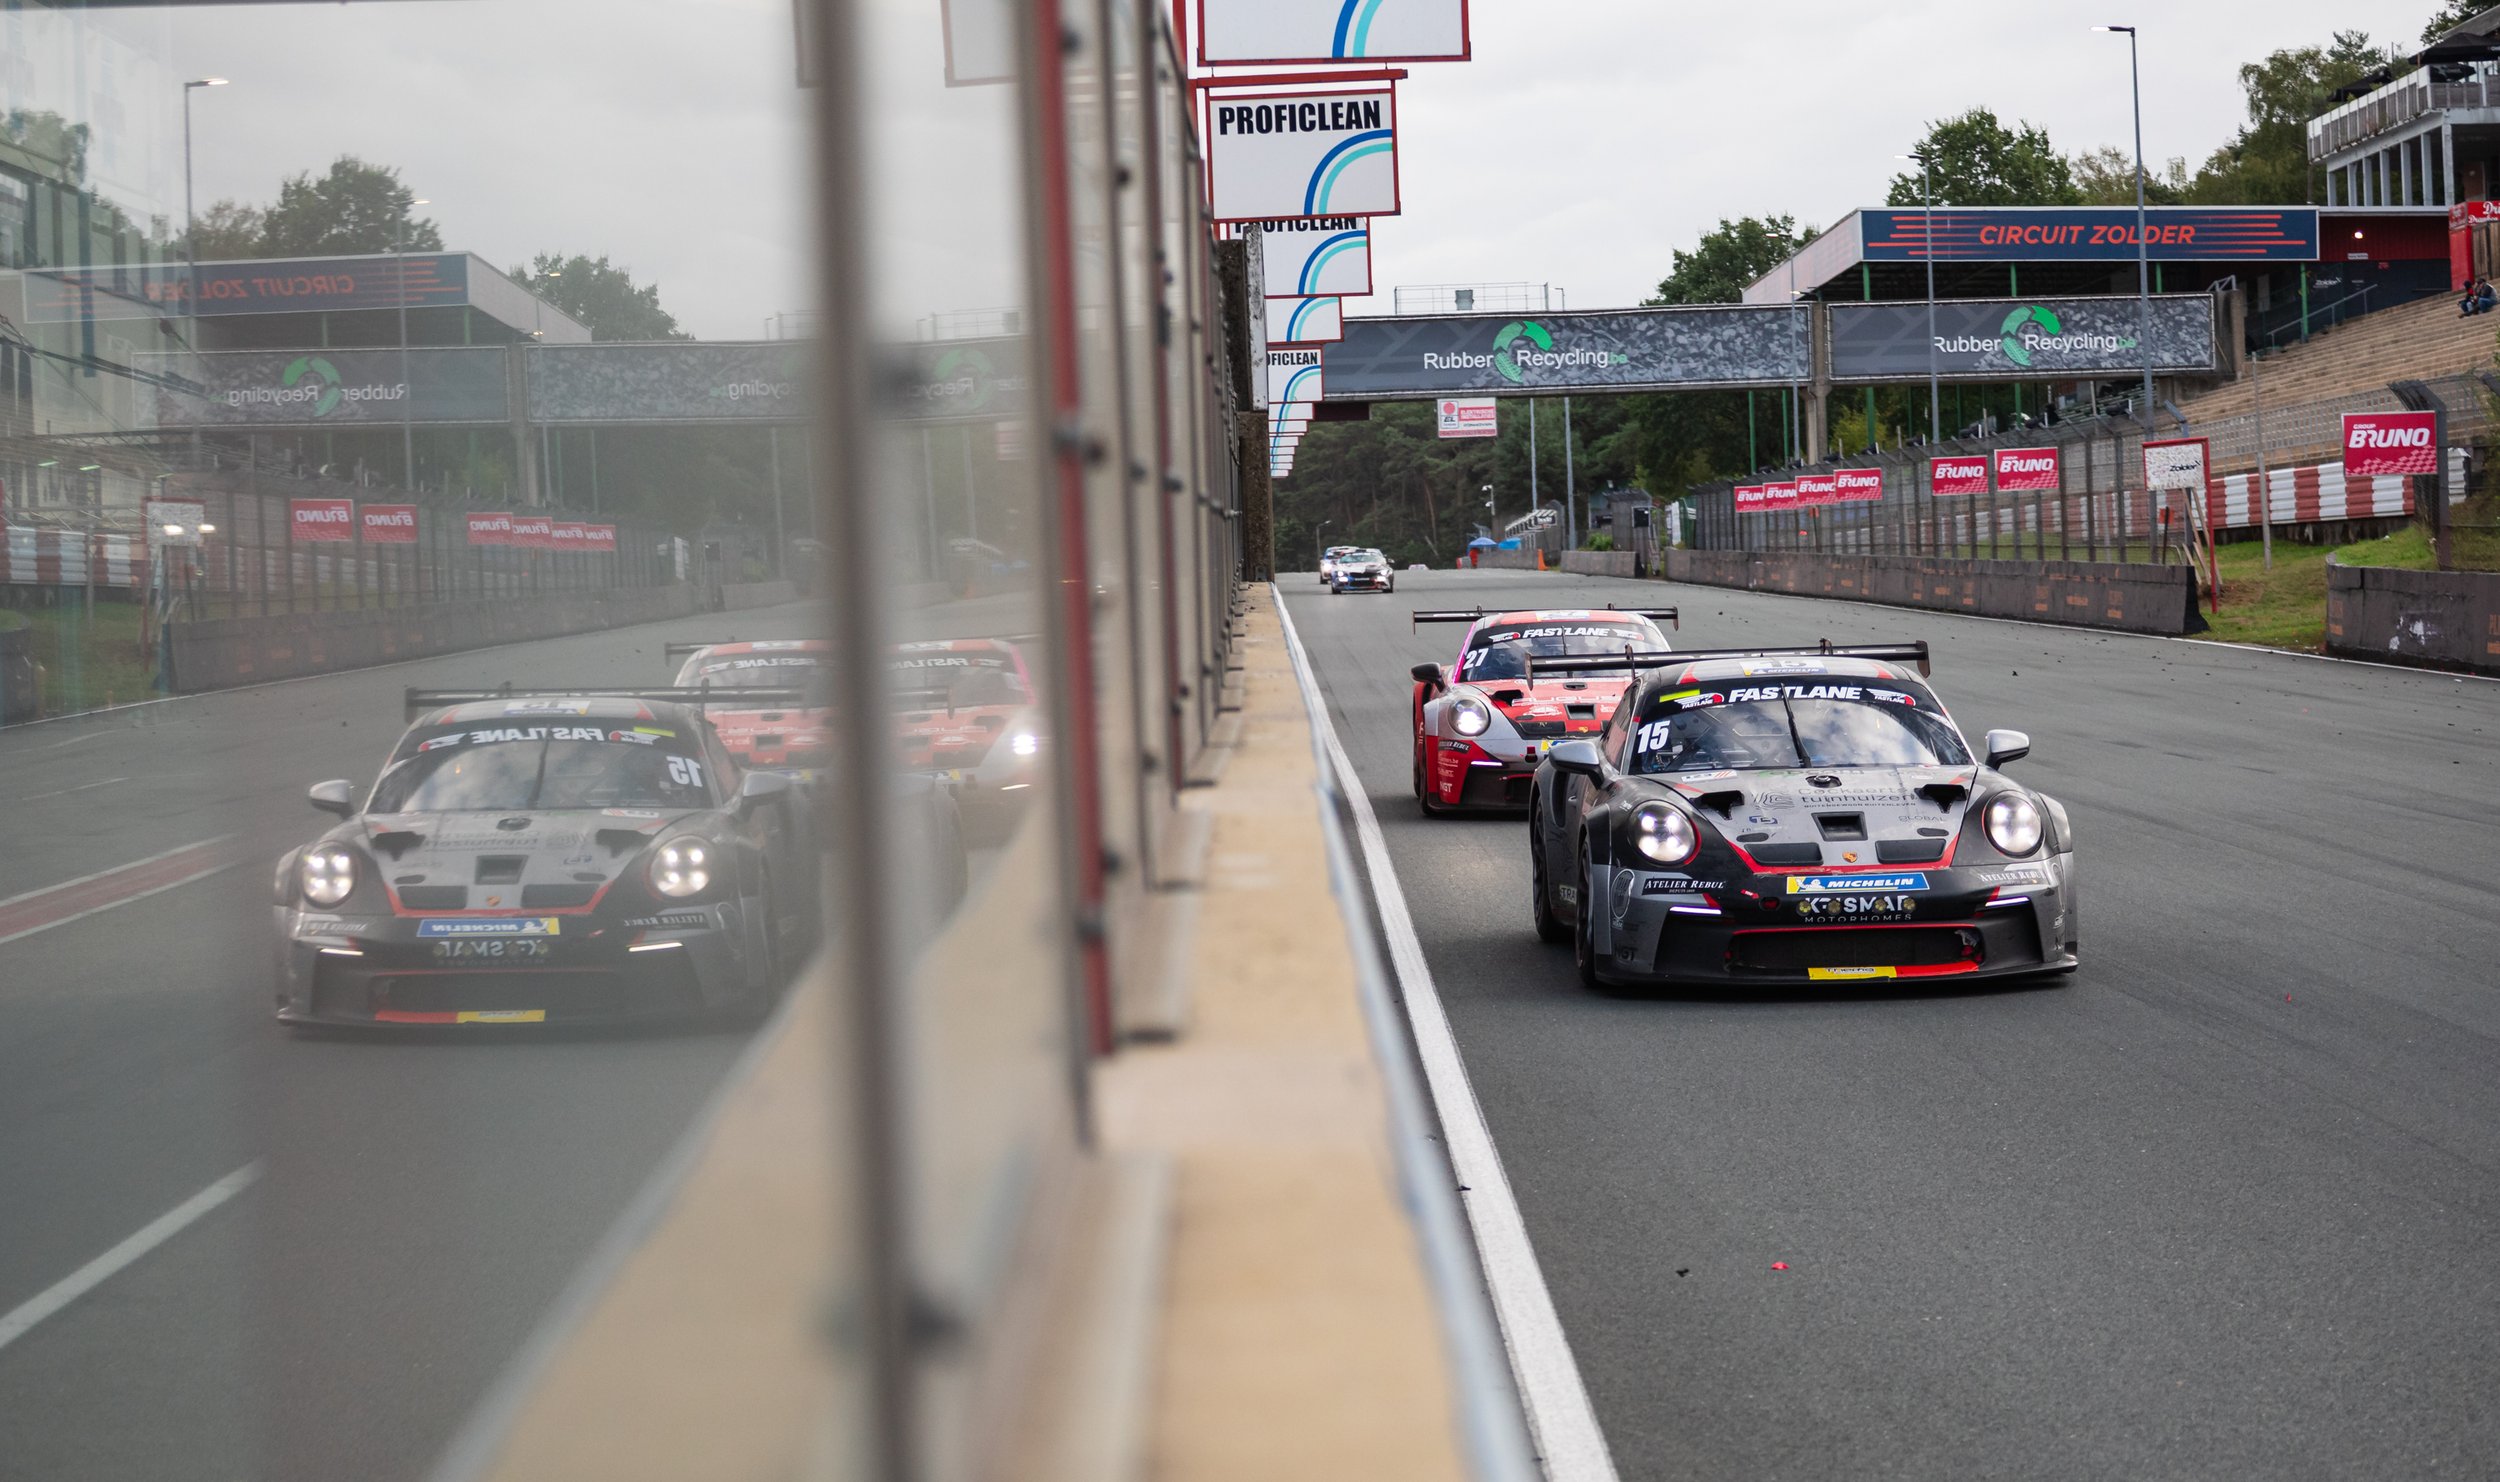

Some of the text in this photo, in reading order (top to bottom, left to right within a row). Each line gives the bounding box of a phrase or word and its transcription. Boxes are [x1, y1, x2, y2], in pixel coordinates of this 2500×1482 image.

[1219, 100, 1381, 135] PROFICLEAN
[1235, 217, 1357, 233] POFICLEAN
[1979, 225, 2196, 244] CIRCUIT ZOLDER
[1934, 336, 2001, 352] Rubber
[1424, 352, 1494, 369] Rubber
[2349, 428, 2430, 448] BRUNO
[1935, 465, 1984, 479] BRUNO
[2000, 458, 2054, 473] BRUNO
[1838, 477, 1879, 487] BRUNO
[1737, 491, 1764, 501] BRUN
[1766, 488, 1797, 498] BRUN
[1523, 628, 1609, 638] FASTLANE
[1463, 648, 1489, 670] 27
[1728, 687, 1862, 702] FASTLANE
[1637, 720, 1670, 753] 15
[1645, 880, 1724, 889] ATELIER REBUL
[1827, 877, 1914, 888] MICHELIN
[1980, 872, 2017, 882] ATELIER
